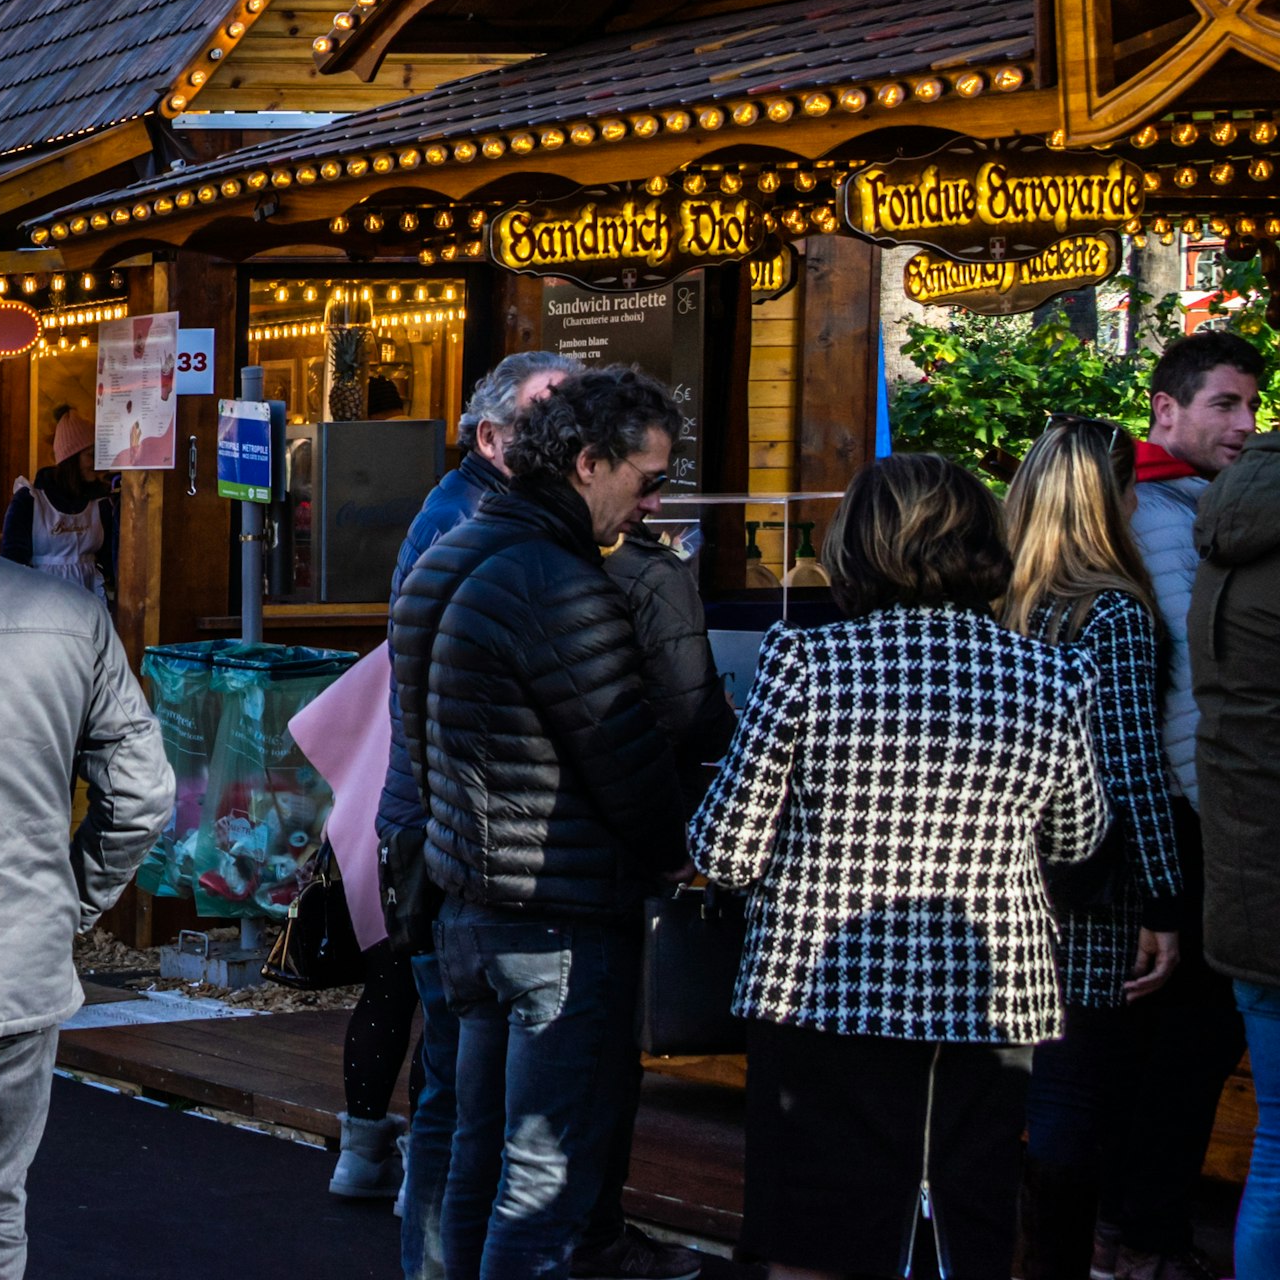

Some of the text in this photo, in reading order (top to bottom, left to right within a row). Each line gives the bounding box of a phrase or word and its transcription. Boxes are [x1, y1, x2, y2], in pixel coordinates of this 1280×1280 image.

[863, 162, 1140, 230] Fondue Savoyarde
[506, 202, 755, 263] Sandwich Diot
[548, 295, 611, 316] Sandwich
[614, 292, 667, 309] raclette
[562, 312, 645, 329] (Charcuterie au choix)
[559, 336, 609, 350] Jambon blanc
[176, 351, 208, 372] 33
[588, 350, 601, 359] cru
